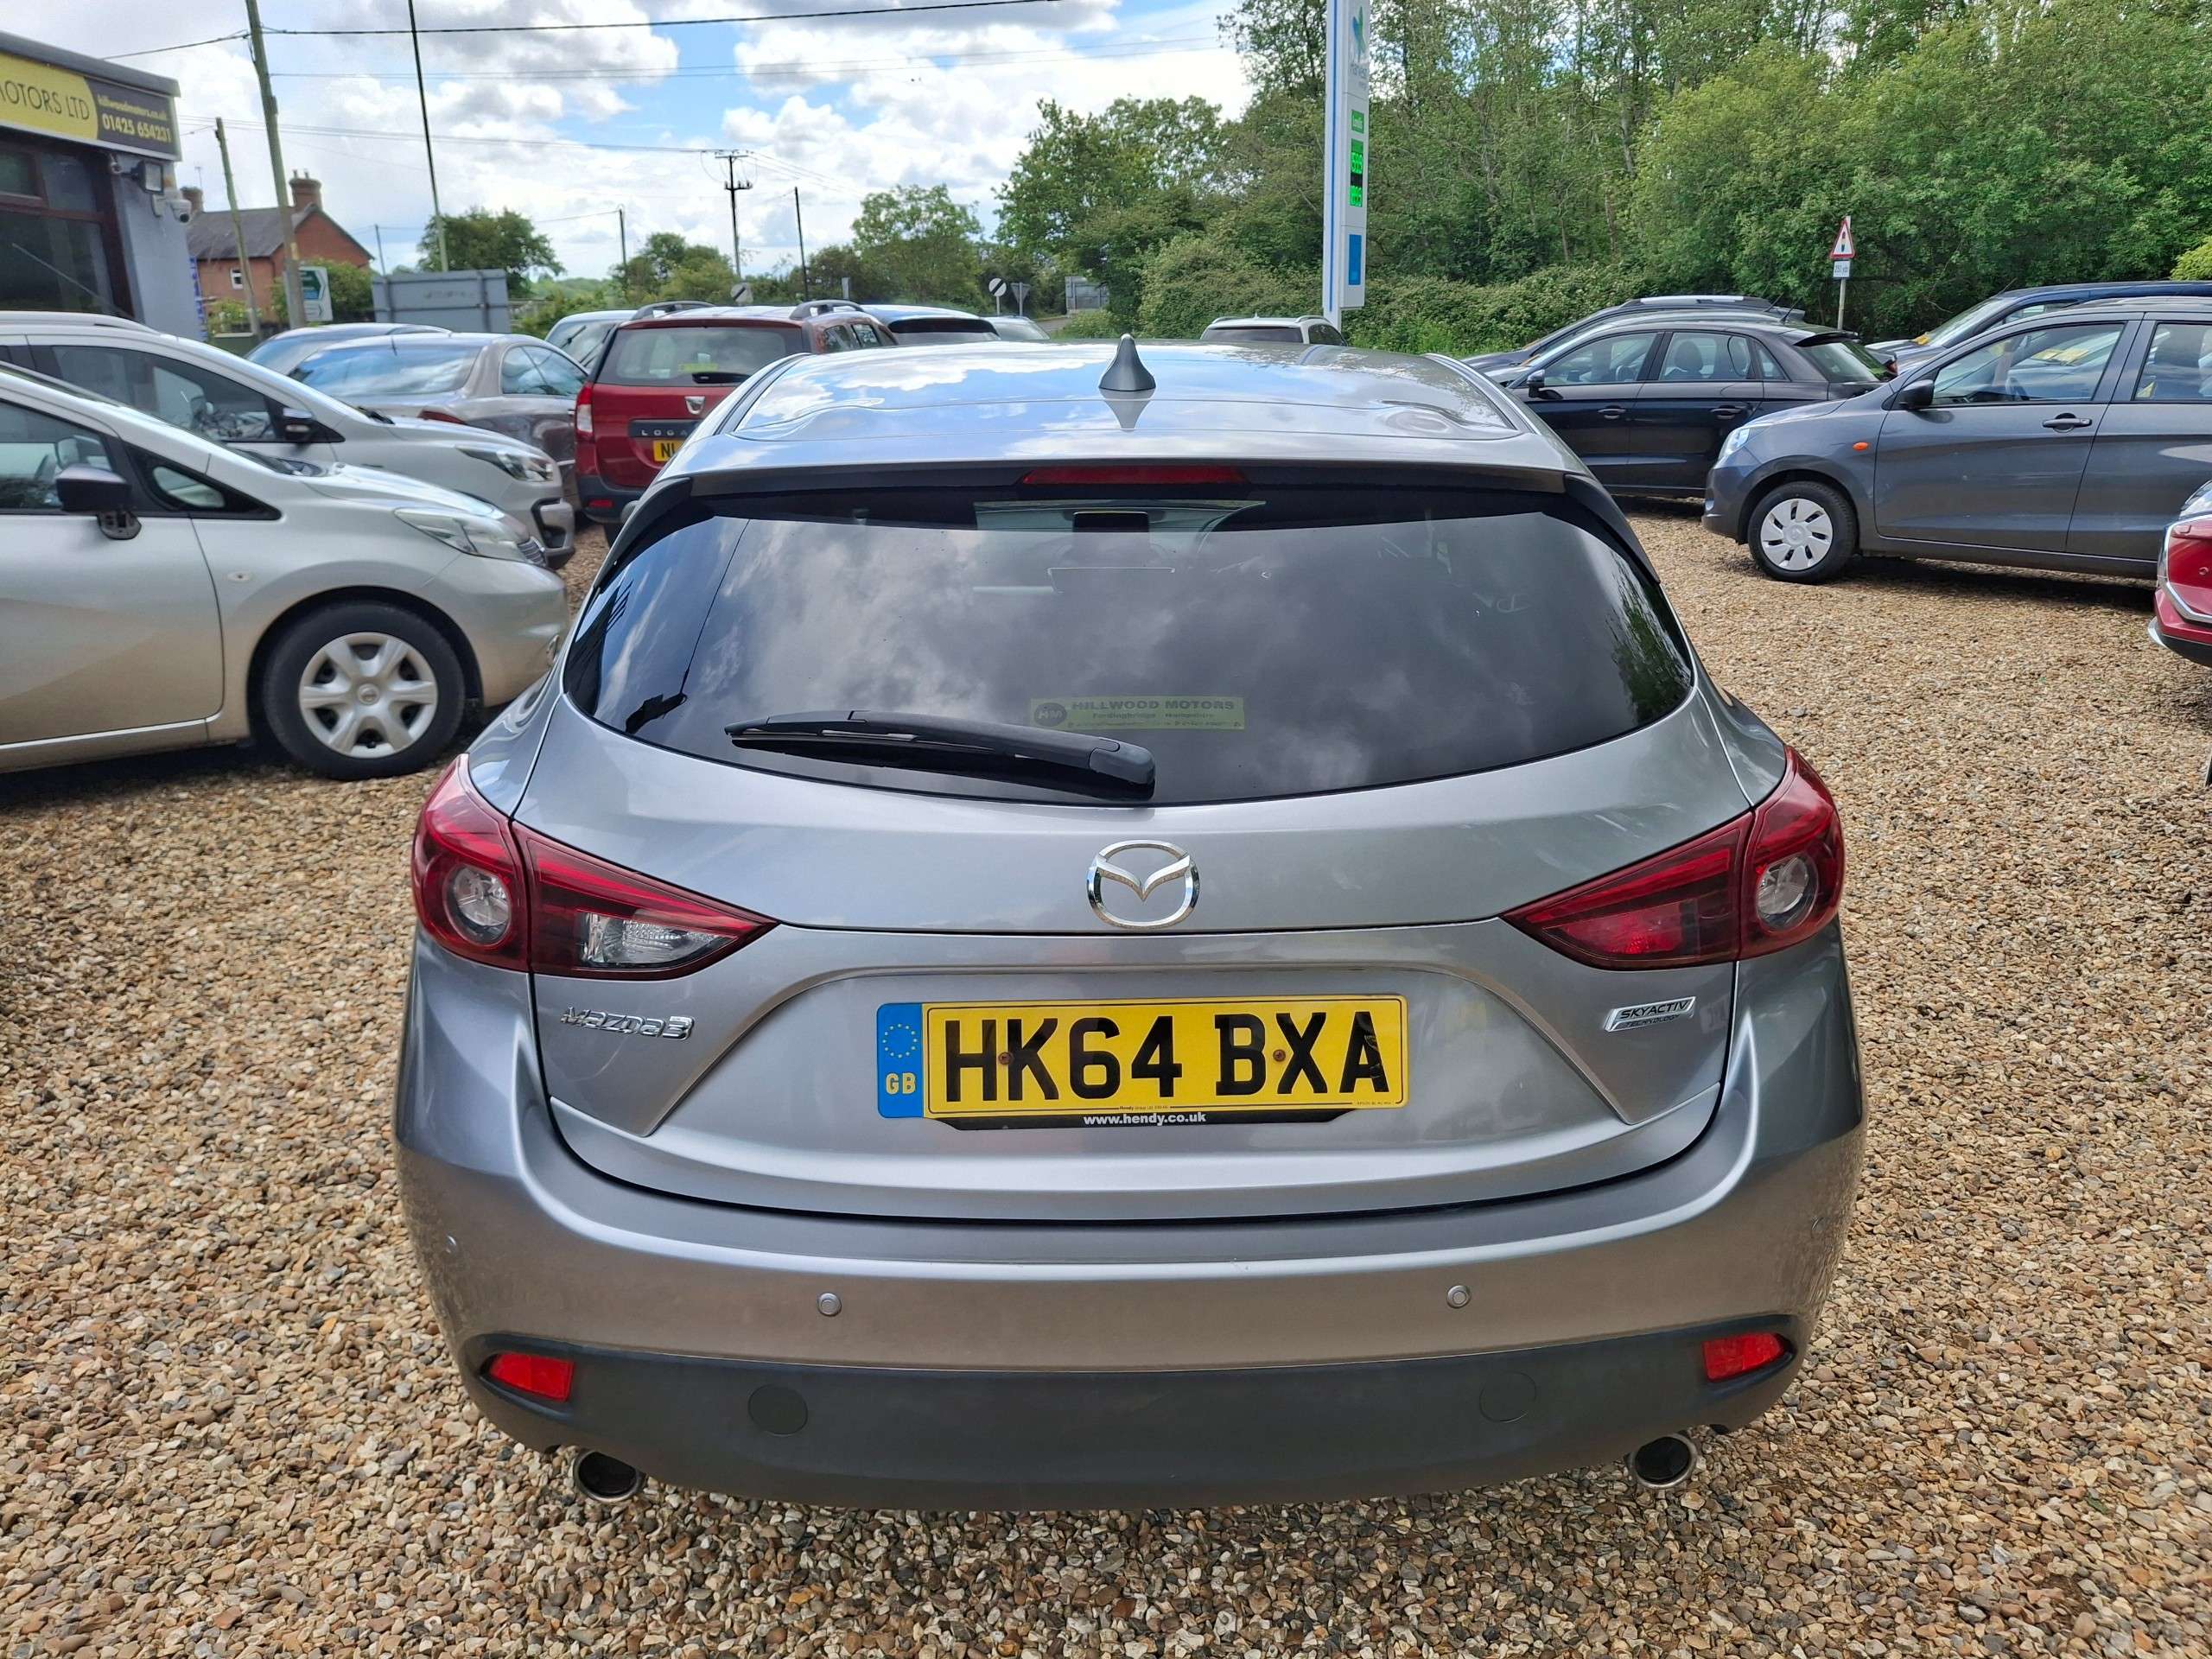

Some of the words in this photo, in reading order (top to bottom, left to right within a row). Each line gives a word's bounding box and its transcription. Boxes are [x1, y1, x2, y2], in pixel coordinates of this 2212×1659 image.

[66, 95, 90, 120] LTD
[102, 113, 136, 135] 01425
[1071, 701, 1160, 710] HILLWOOD
[1165, 701, 1235, 709] MOTORS
[1620, 1000, 1688, 1020] SKYACTIV
[945, 1015, 1182, 1102] HK64
[1214, 1011, 1389, 1096] BXA
[886, 1072, 917, 1095] GB
[1083, 1111, 1207, 1126] www.hendy.co.uk
